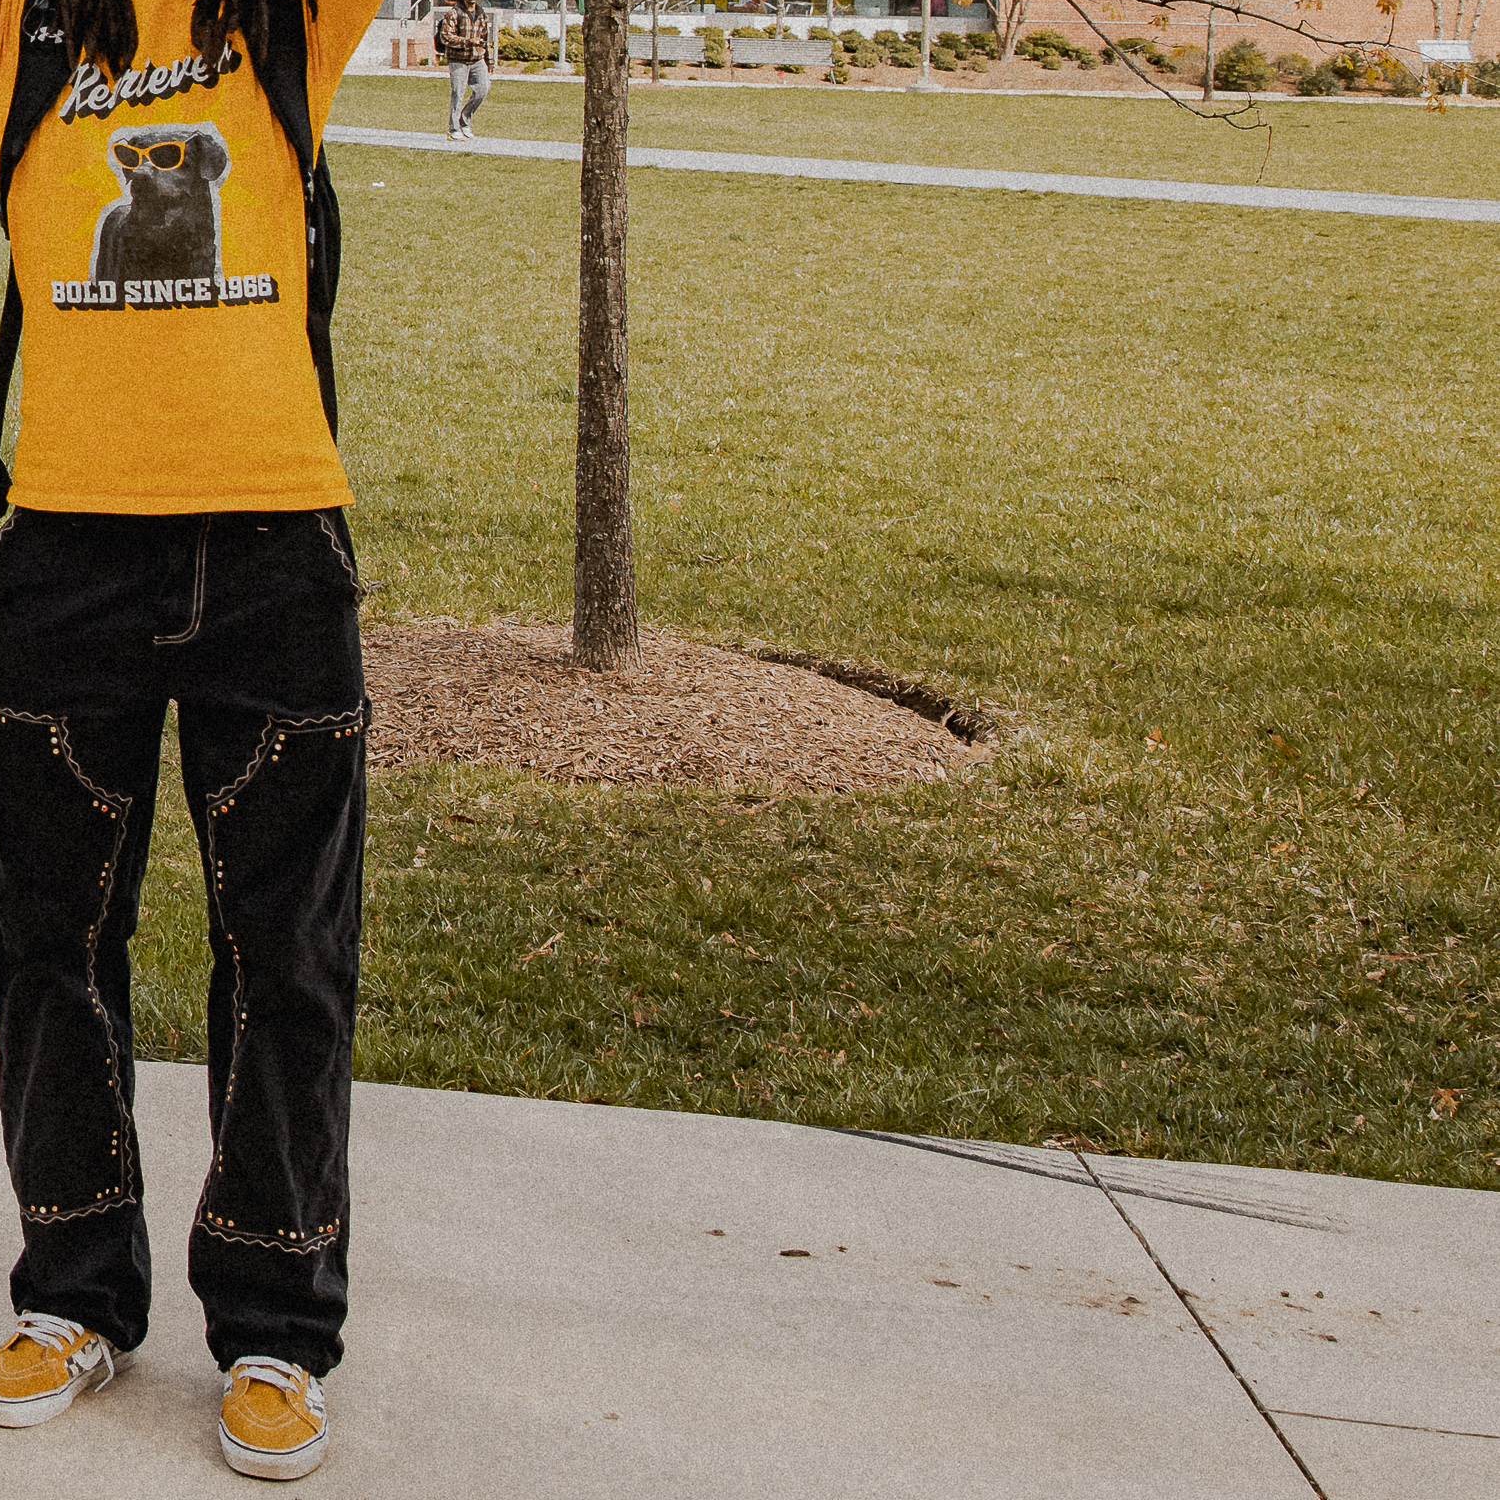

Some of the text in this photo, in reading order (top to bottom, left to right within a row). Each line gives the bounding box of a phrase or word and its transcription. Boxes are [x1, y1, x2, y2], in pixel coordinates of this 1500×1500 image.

[50, 273, 275, 305] BOLD SINCE 1966
